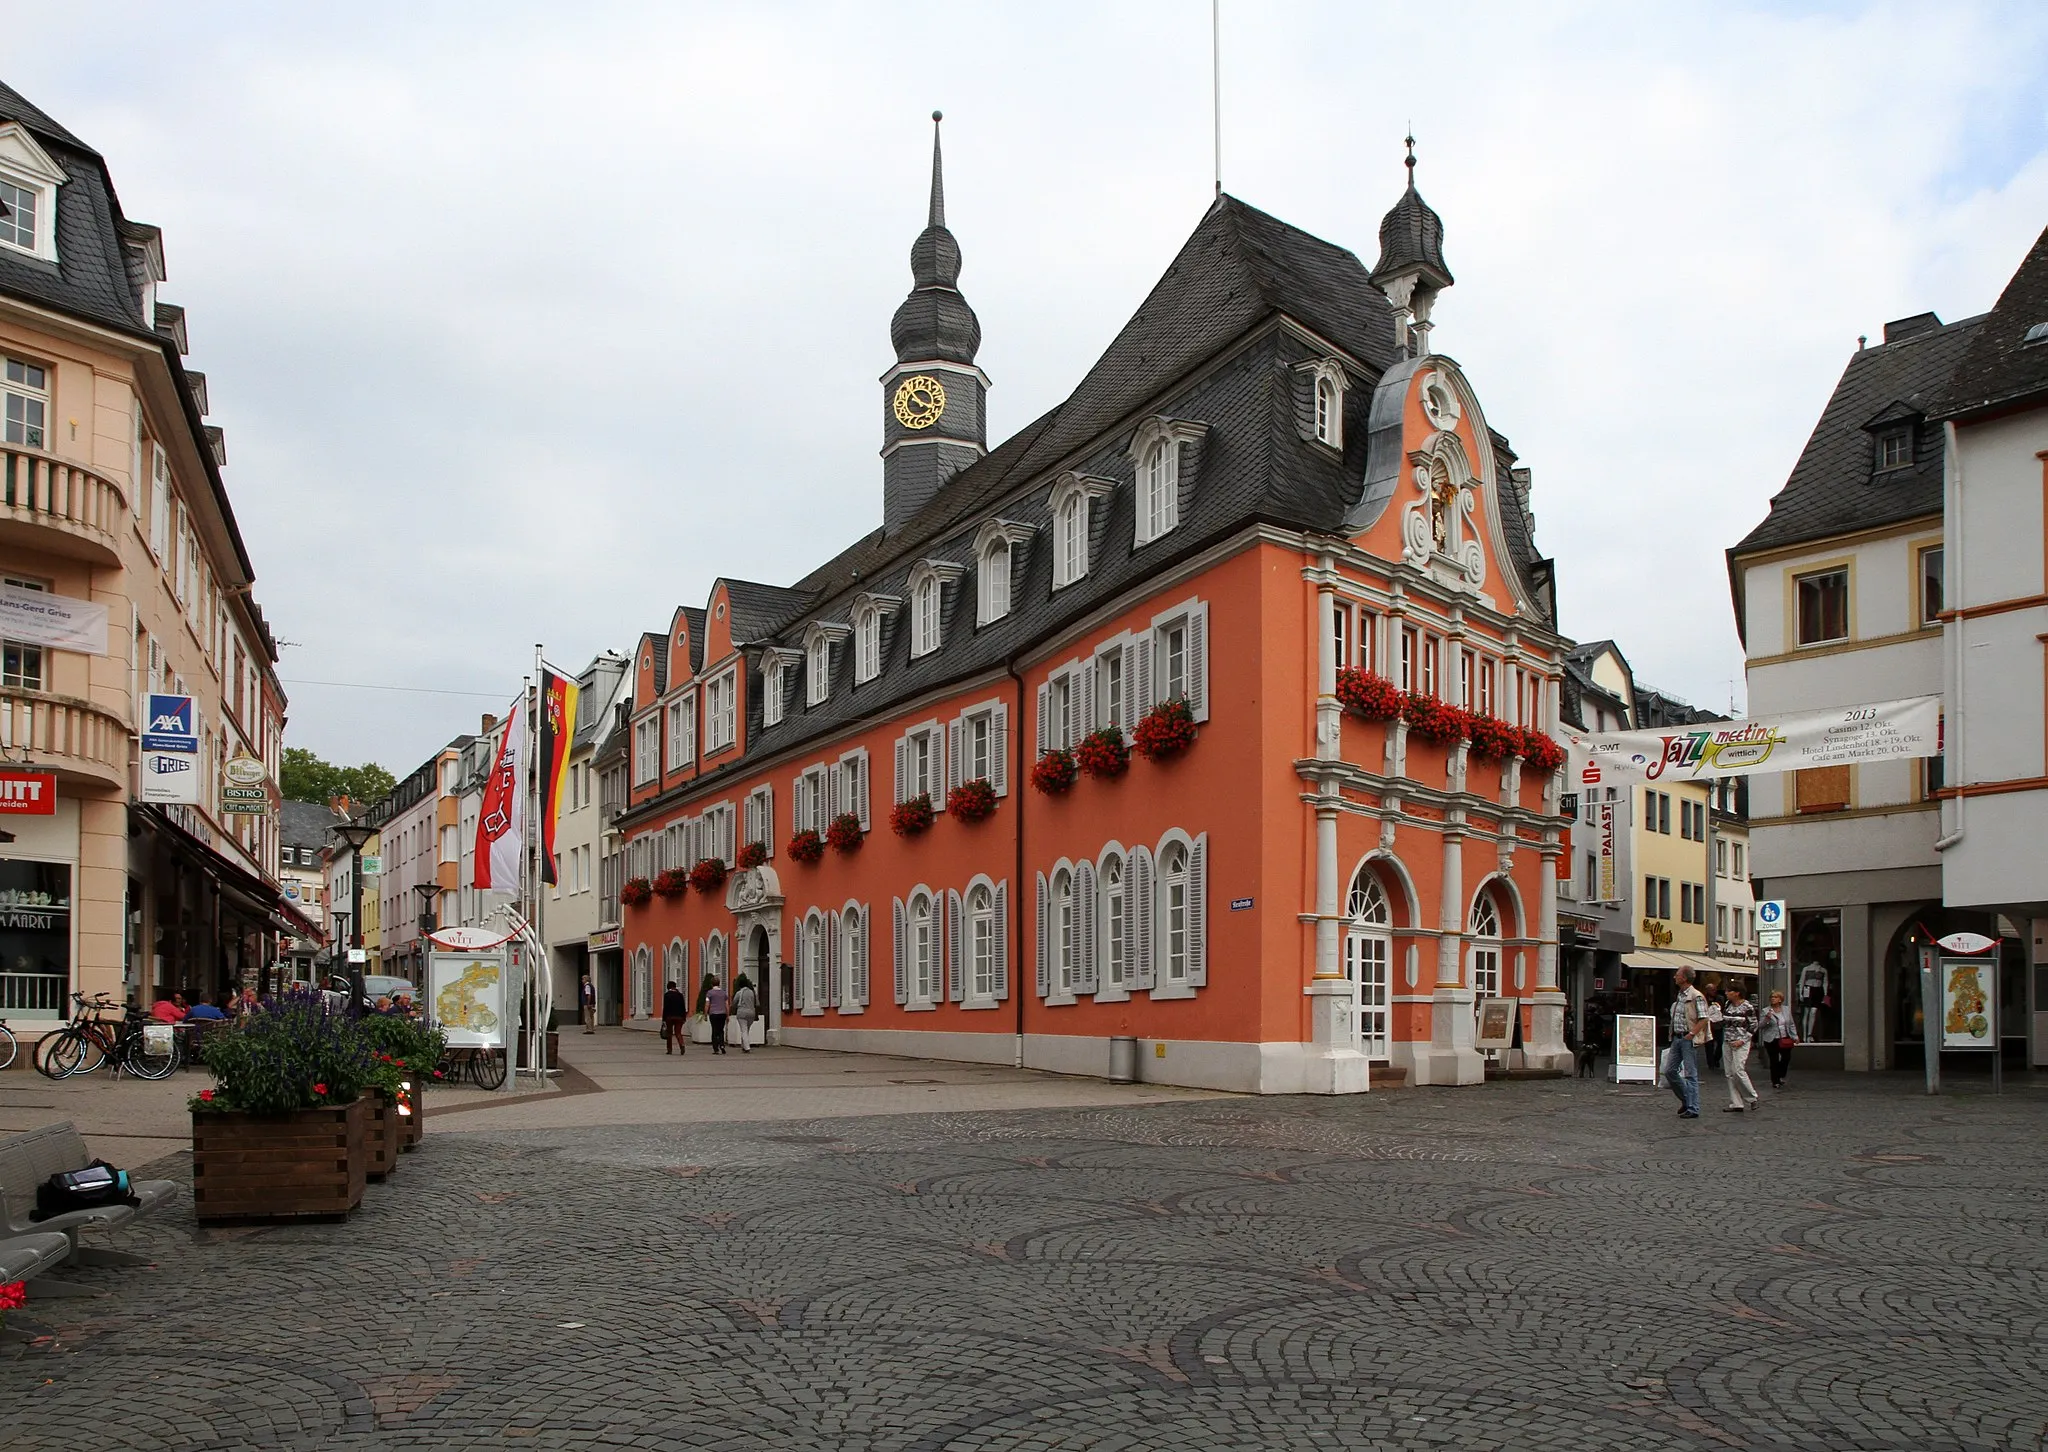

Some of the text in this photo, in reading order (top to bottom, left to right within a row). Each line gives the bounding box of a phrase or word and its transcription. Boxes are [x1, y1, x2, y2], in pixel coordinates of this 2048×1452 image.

[48, 608, 71, 618] Gries
[1844, 708, 1876, 722] 2013
[150, 714, 184, 732] AXA
[1716, 722, 1778, 743] meeting
[1828, 726, 1858, 734] Casino
[1824, 734, 1864, 746] Synagoge
[1600, 744, 1620, 752] SWT
[1728, 748, 1758, 758] wittlich
[1802, 746, 1824, 754] Hotel
[1826, 740, 1870, 752] Lindenhof
[1848, 749, 1874, 758] Markt
[160, 758, 190, 772] GRIES
[0, 780, 42, 800] ITT
[226, 789, 262, 798] BISTRO
[9, 914, 52, 929] MARKT
